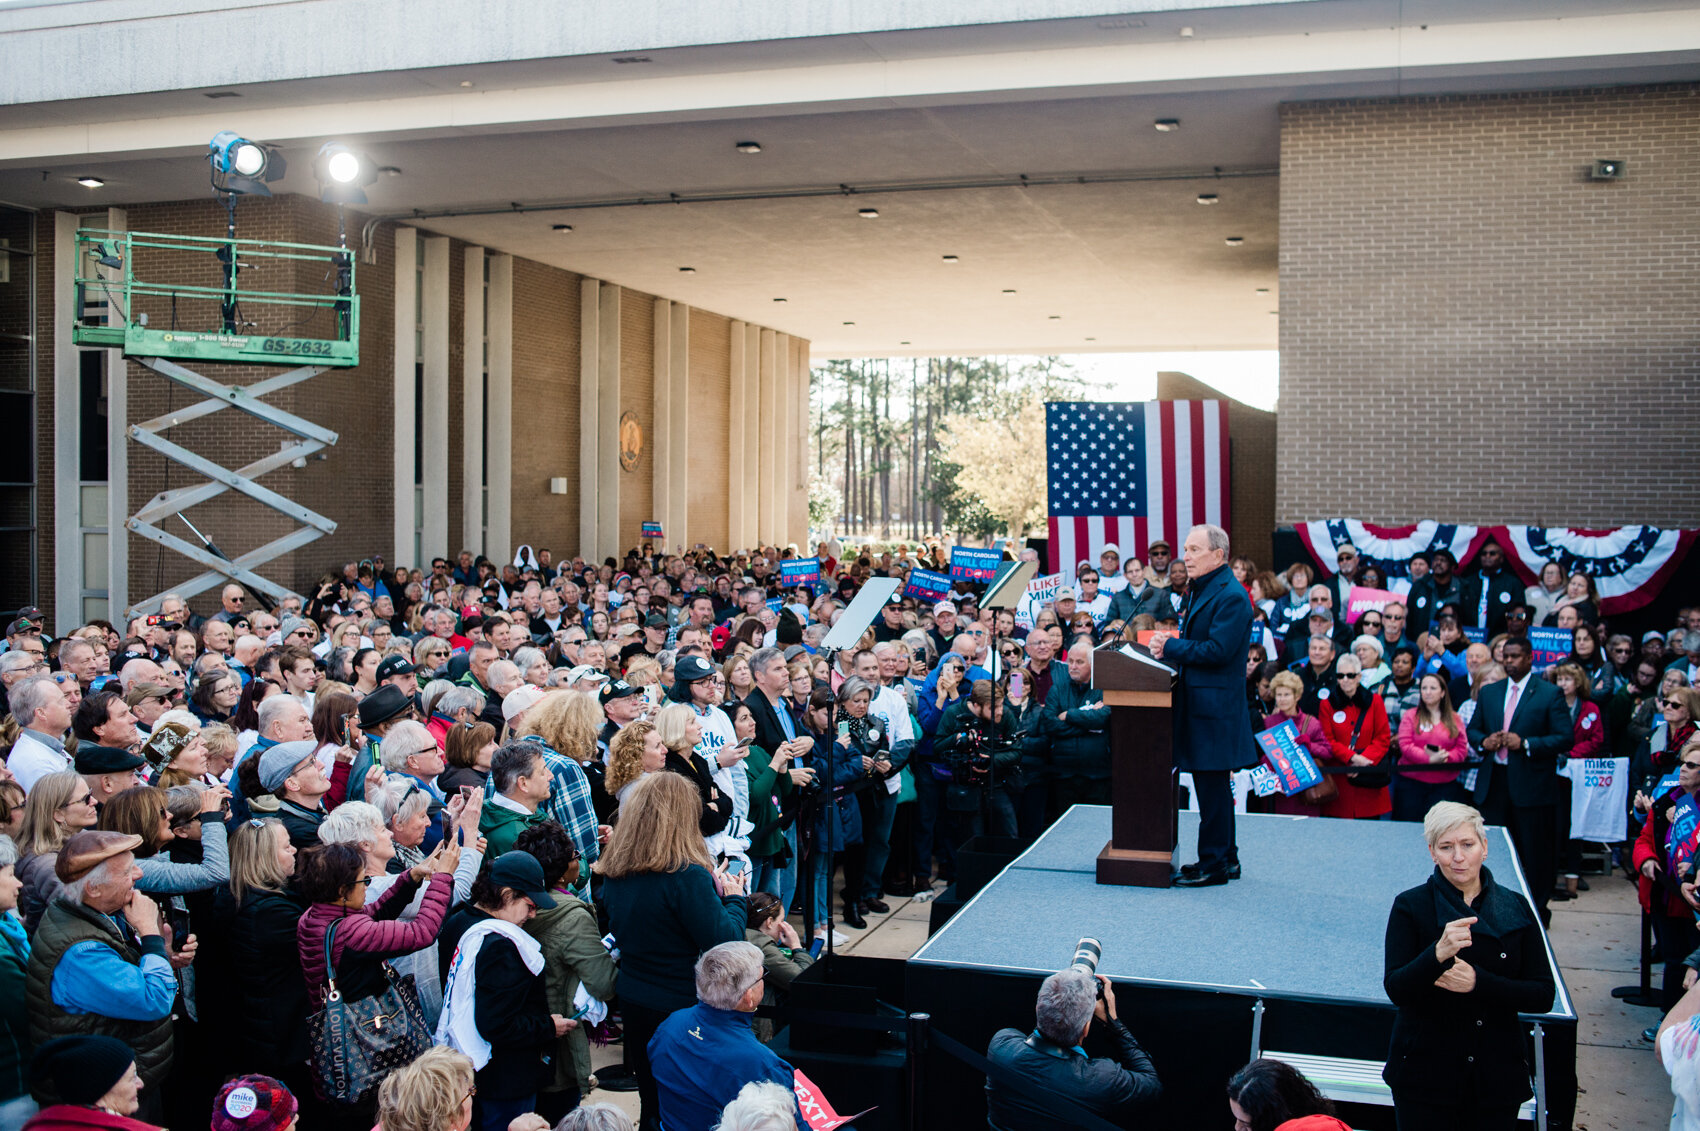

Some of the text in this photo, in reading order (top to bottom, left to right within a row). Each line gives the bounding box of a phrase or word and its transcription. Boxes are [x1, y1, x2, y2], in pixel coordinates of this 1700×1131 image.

[262, 338, 332, 355] GS-2632
[954, 550, 1000, 560] NORTH CAROLINA
[953, 557, 999, 569] WILL GET
[782, 565, 818, 575] WILL GET
[952, 566, 963, 576] IT
[783, 573, 818, 583] IT DONE
[913, 571, 951, 584] NORTH CAROLINA
[1033, 576, 1060, 591] LIKE
[907, 585, 918, 594] IT
[911, 576, 951, 593] WILL GET
[1531, 631, 1552, 639] NORTH
[1532, 640, 1556, 651] WILL
[1274, 729, 1311, 783] WILL GET
[1283, 725, 1317, 781] NORTH CAROLINA
[1262, 733, 1277, 746] IT
[1271, 748, 1300, 790] DONE
[1584, 759, 1615, 769] mike
[1259, 777, 1281, 794] 202
[1584, 776, 1613, 787] 2020
[396, 981, 416, 1011] LOUIS
[329, 1008, 346, 1099] LOUIS VUITTON
[231, 1092, 254, 1102] mike
[794, 1078, 828, 1122] TEXT
[230, 1103, 252, 1112] 2020
